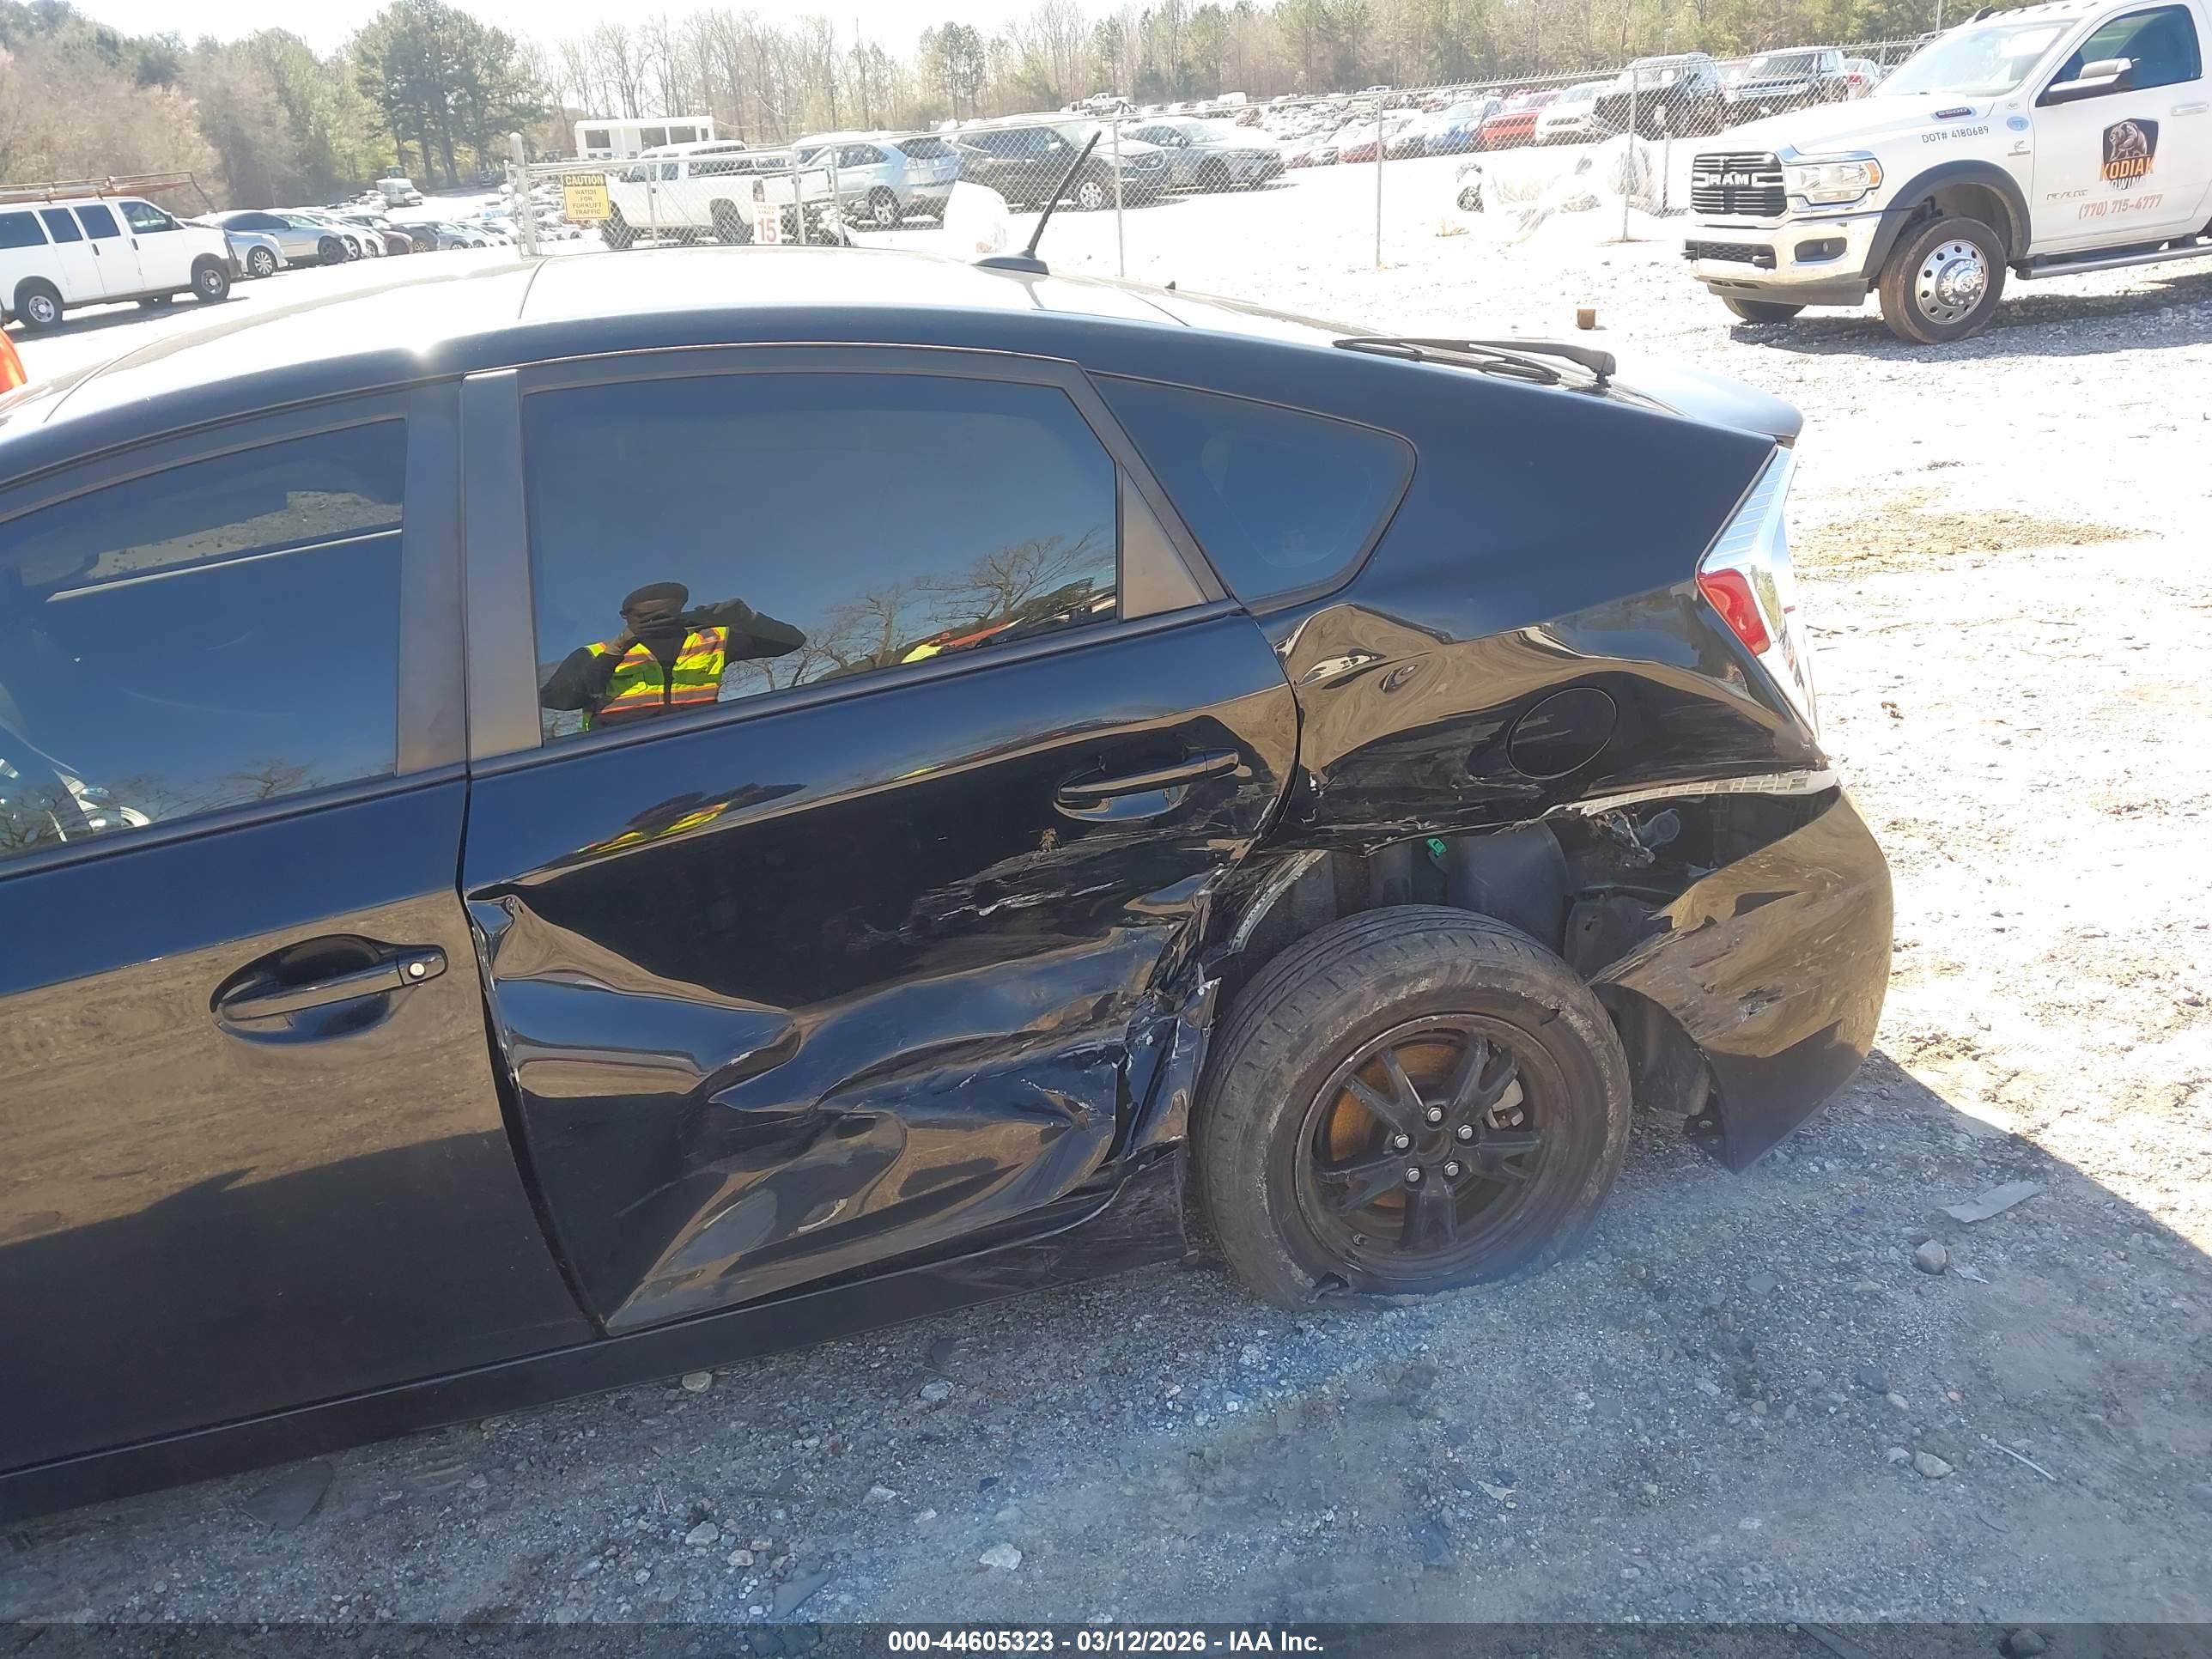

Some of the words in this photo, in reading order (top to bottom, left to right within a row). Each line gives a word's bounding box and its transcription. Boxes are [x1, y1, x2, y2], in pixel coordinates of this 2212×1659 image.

[1921, 131, 1948, 143] DOT#
[1951, 125, 1989, 138] 4180689
[2096, 156, 2157, 181] KODIAK
[565, 175, 604, 185] CAUTION
[1709, 173, 1749, 185] RAM
[2078, 200, 2108, 220] (770)
[757, 217, 777, 242] 15
